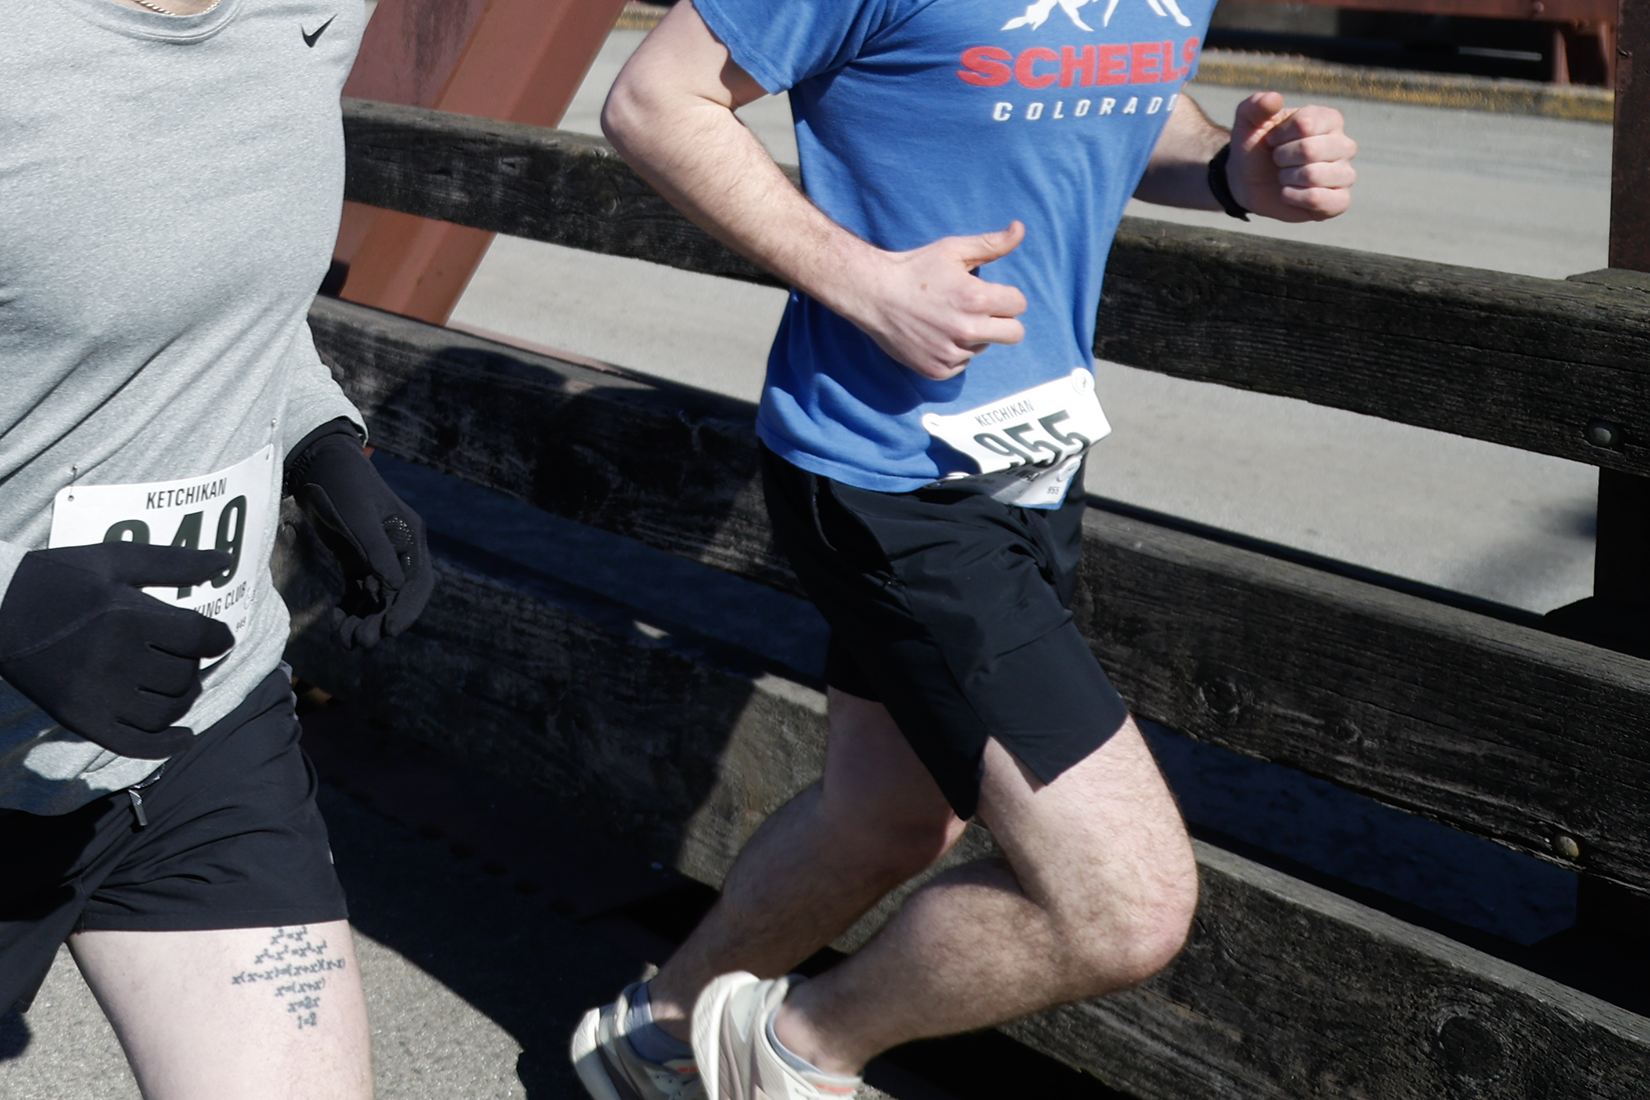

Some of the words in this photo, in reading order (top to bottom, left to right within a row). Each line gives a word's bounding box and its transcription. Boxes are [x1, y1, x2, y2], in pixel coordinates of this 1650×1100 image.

[956, 36, 1200, 89] SCHEELS
[992, 93, 1179, 122] COLORADO
[974, 399, 1035, 427] KETCHIKAN
[973, 409, 1091, 470] 955
[146, 477, 227, 510] KETCHIKAN
[103, 494, 247, 600] 49
